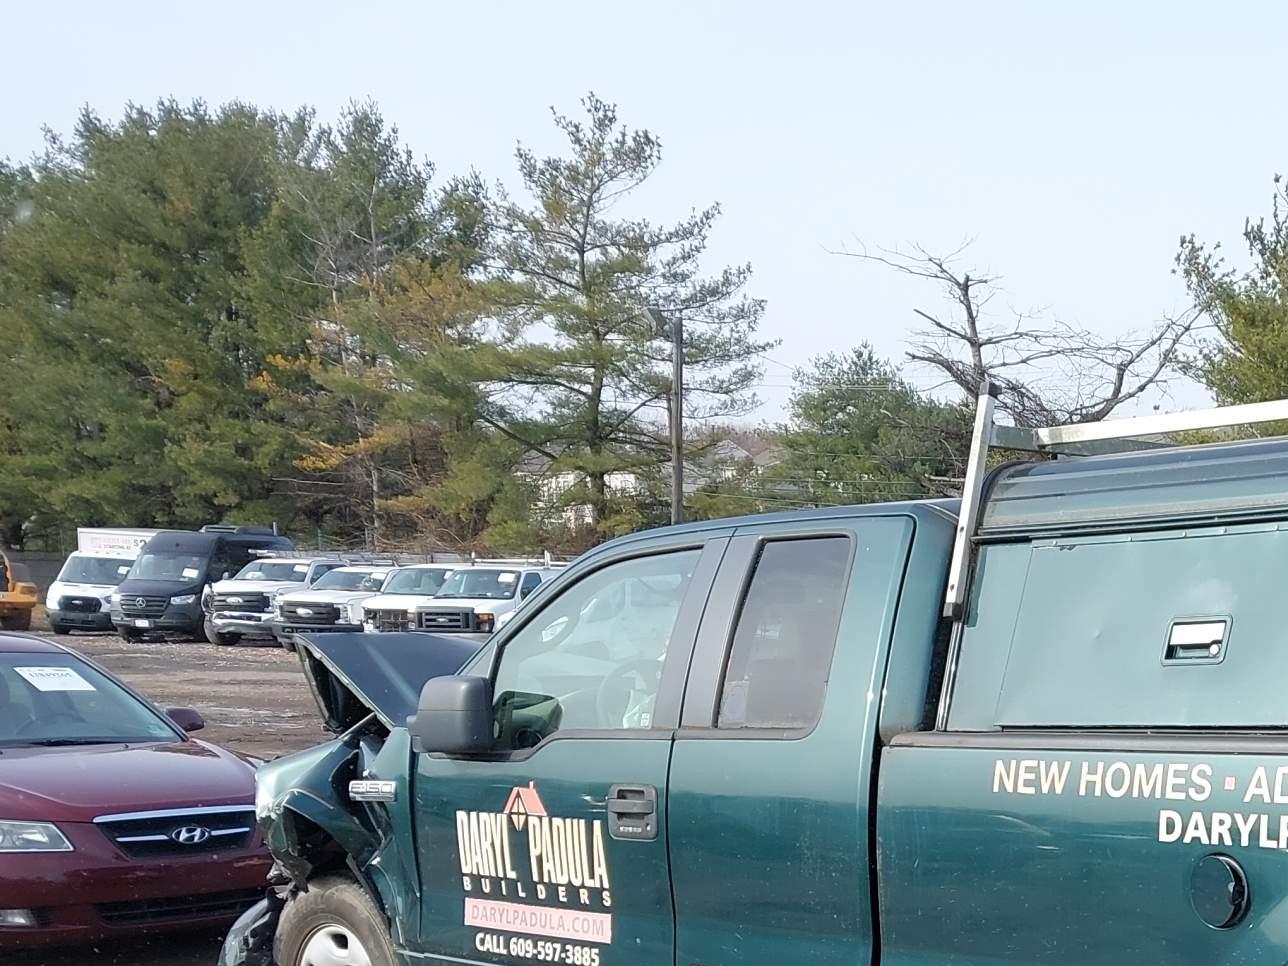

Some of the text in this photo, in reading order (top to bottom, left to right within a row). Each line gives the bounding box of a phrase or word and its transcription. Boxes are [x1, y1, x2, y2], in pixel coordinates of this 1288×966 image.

[992, 759, 1072, 795] NEW
[1078, 761, 1214, 802] HOMES
[456, 810, 610, 889] DARYL PADULA
[462, 875, 612, 908] BUILDERS
[471, 904, 605, 937] DARYLPADULA.COM
[475, 932, 507, 955] CALL
